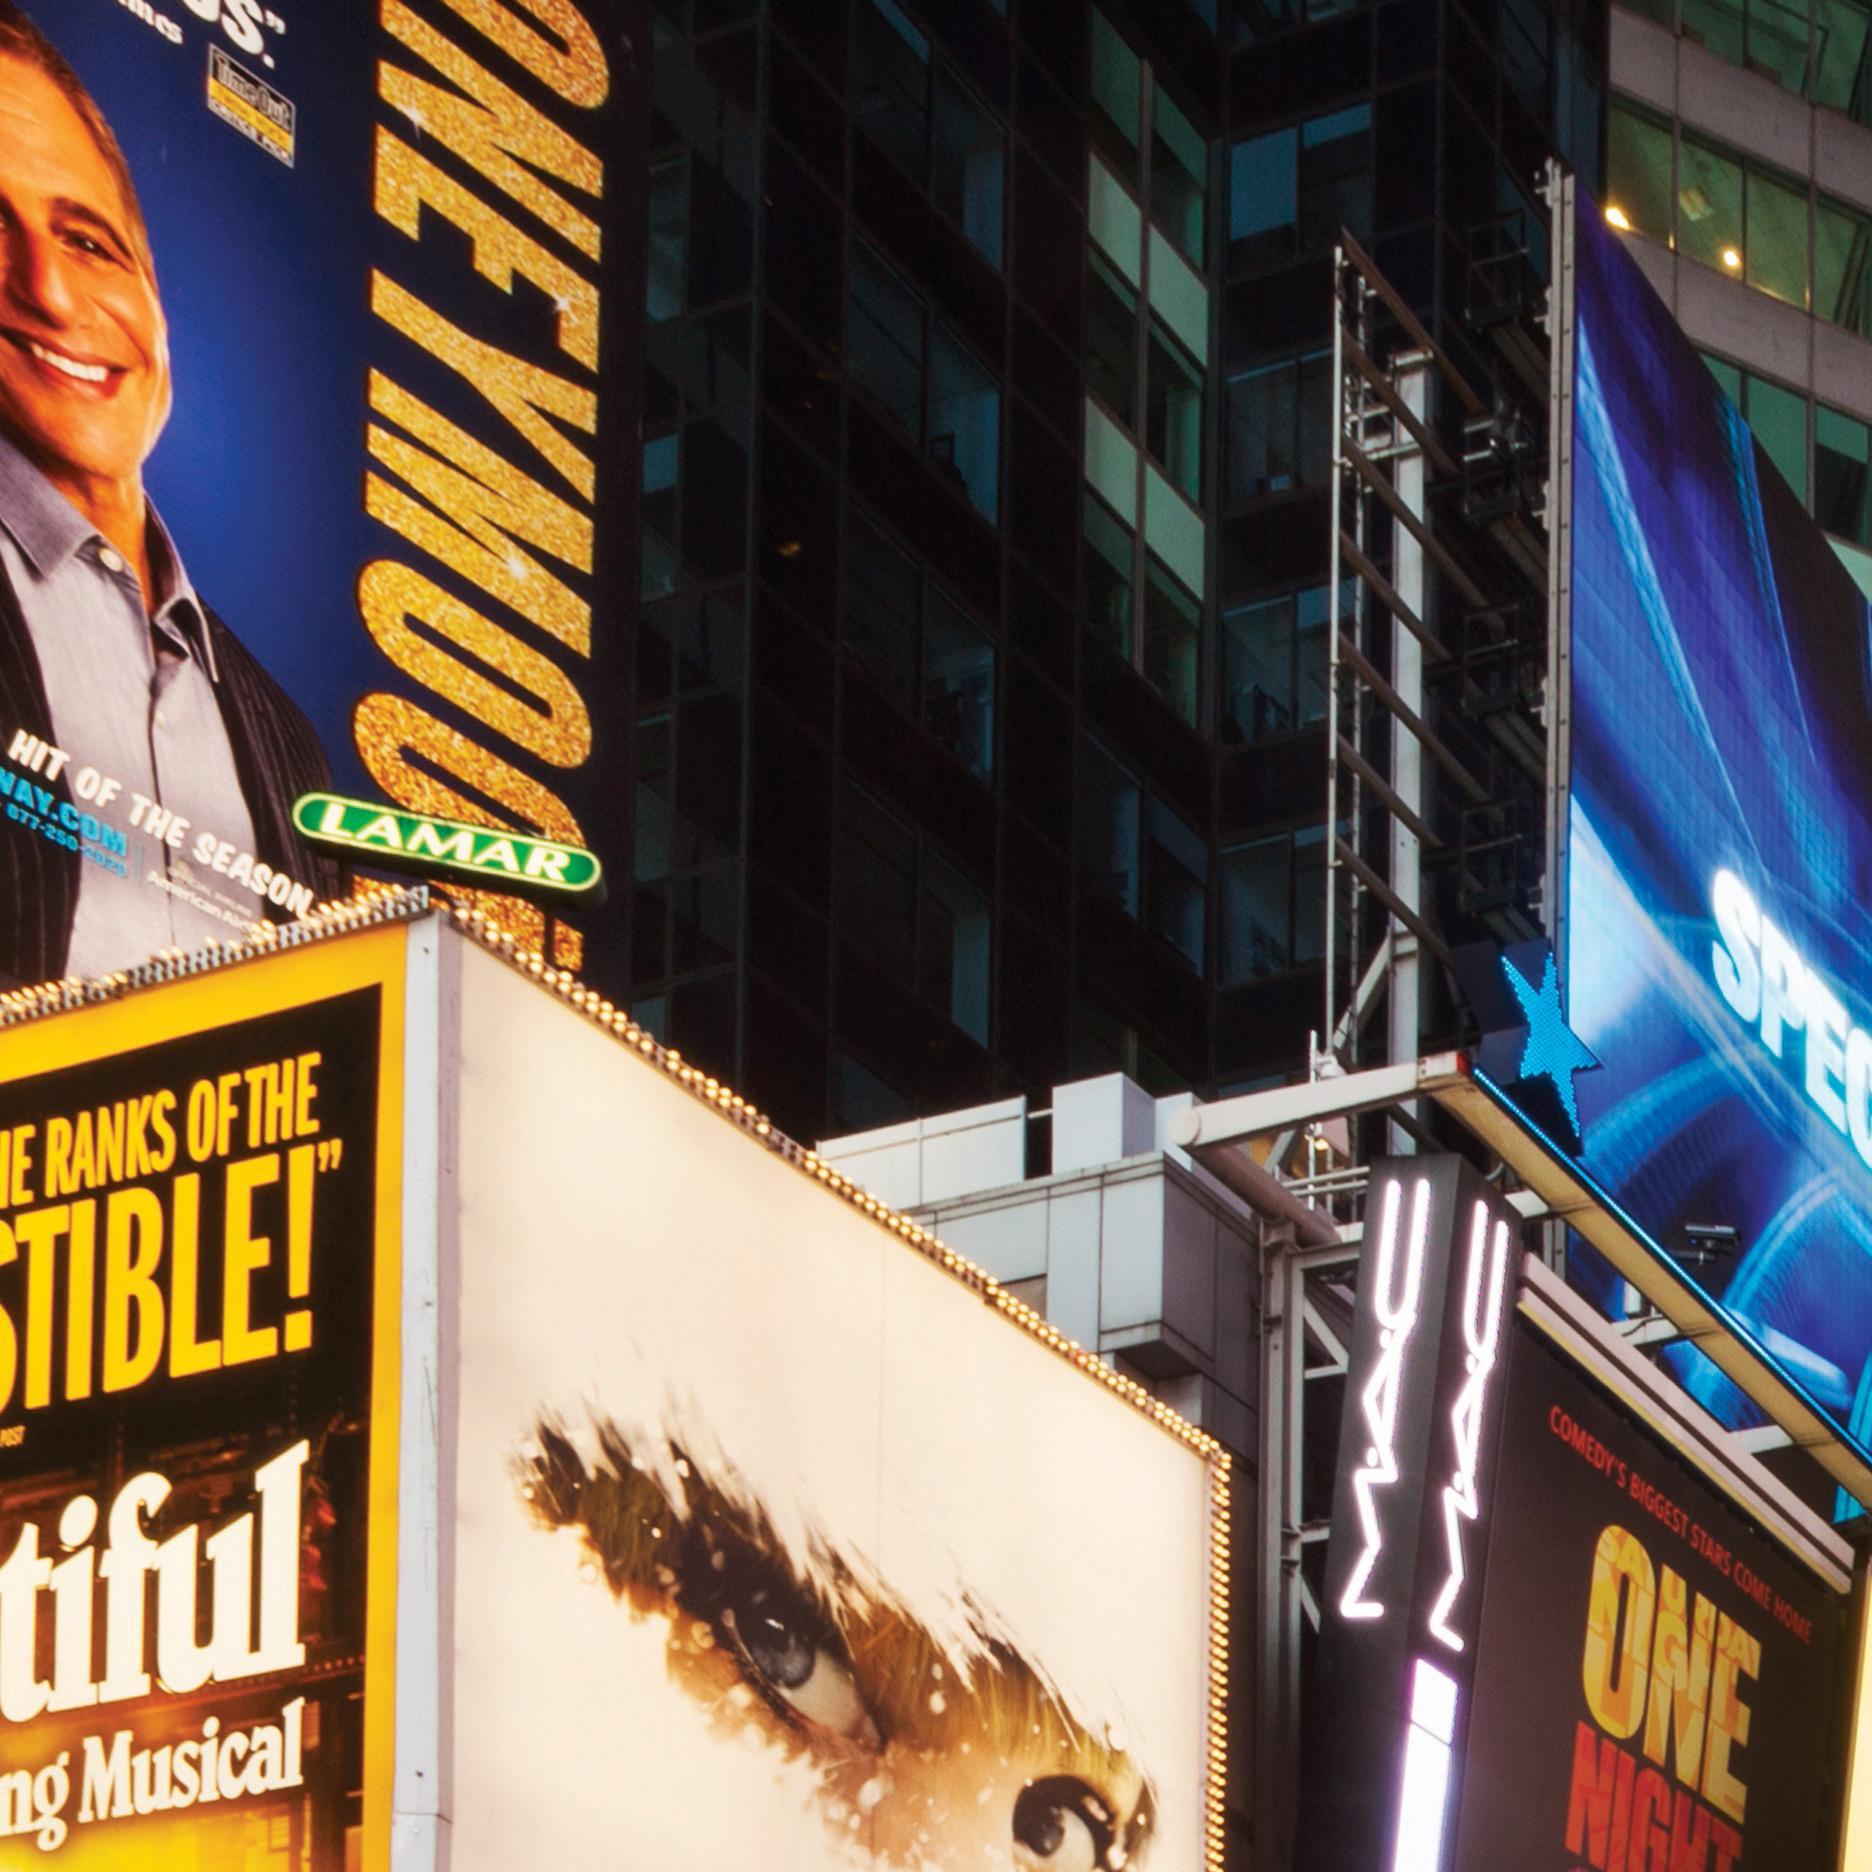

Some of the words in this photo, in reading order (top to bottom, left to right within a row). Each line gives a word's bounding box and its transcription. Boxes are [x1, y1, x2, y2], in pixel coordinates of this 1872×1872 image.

[8, 729, 70, 782] HIT
[75, 767, 122, 808] OF
[129, 793, 191, 849] THE
[193, 832, 315, 922] SEASON
[319, 804, 571, 885] LAMAR
[45, 1087, 177, 1199] RANKS
[189, 1076, 241, 1164] OF
[247, 1051, 323, 1152] THE
[1549, 1406, 1628, 1488] COMEDY'S
[1631, 1473, 1690, 1543] BIGGEST
[1691, 1523, 1732, 1582] STARS
[1734, 1561, 1772, 1614] COME
[1774, 1594, 1813, 1646] HOME
[82, 1696, 305, 1824] Musical
[1581, 1524, 1762, 1826] ONE
